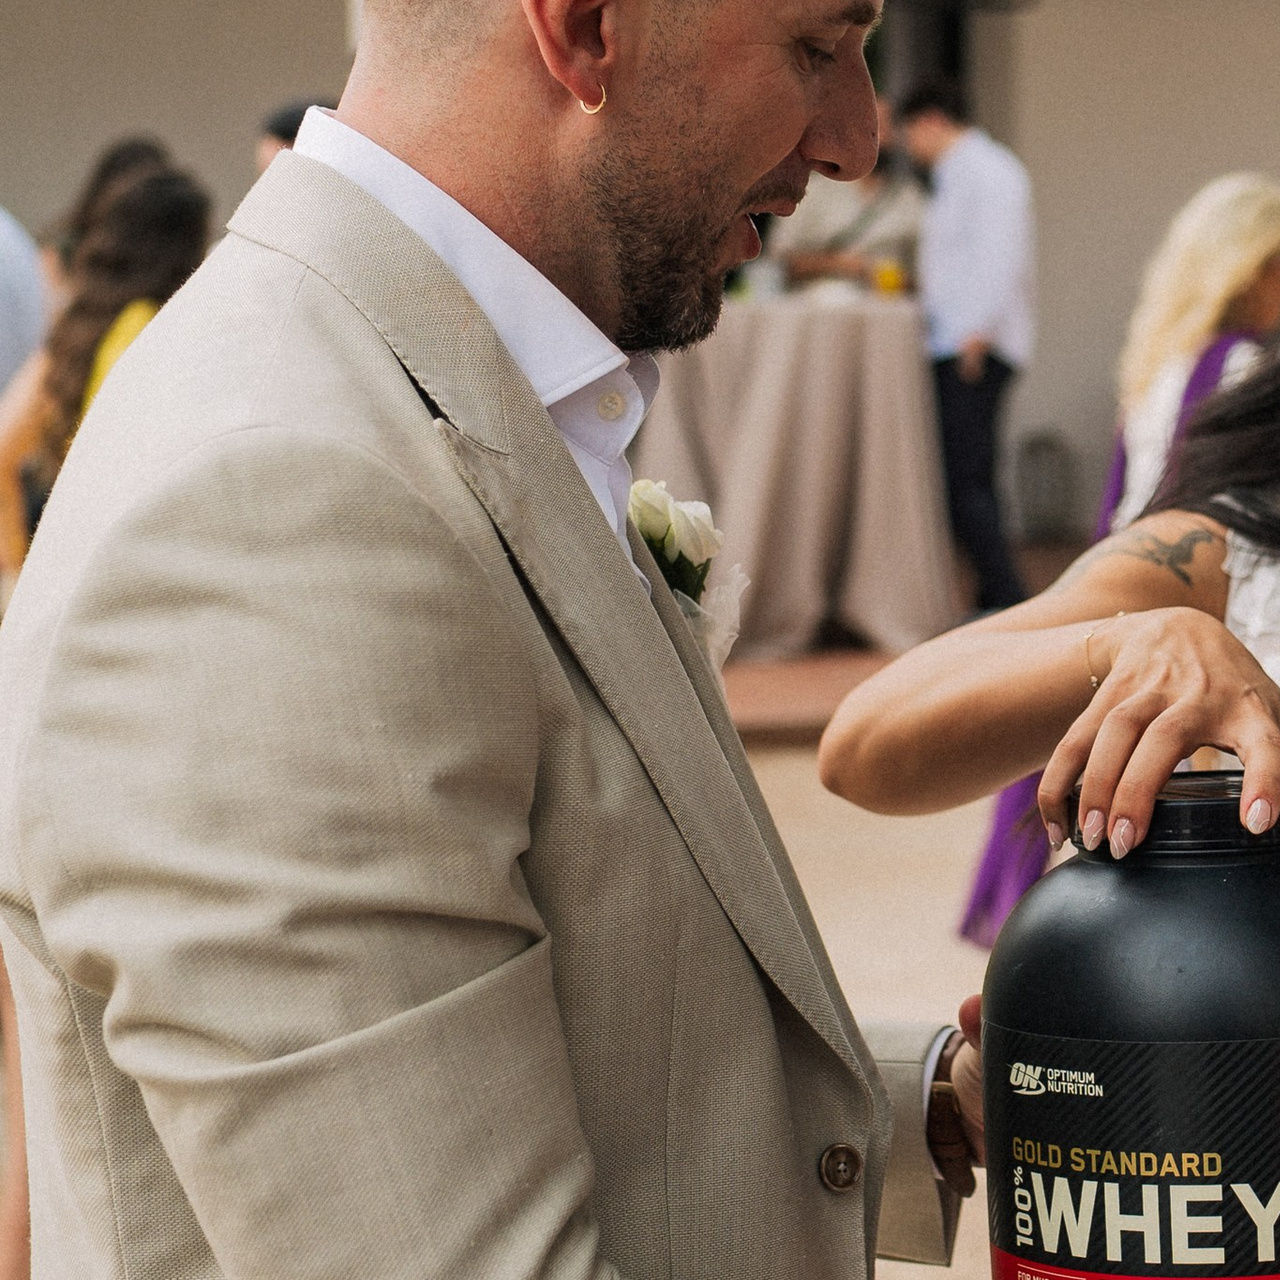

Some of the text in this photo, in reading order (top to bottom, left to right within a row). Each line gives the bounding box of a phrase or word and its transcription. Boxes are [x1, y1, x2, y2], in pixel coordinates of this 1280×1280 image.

[1047, 1068, 1095, 1084] OPTIMUM
[1047, 1080, 1104, 1097] NUTRITION
[1012, 1136, 1062, 1169] GOLD
[1070, 1147, 1222, 1177] STANDARD
[1013, 1165, 1034, 1247] 100%
